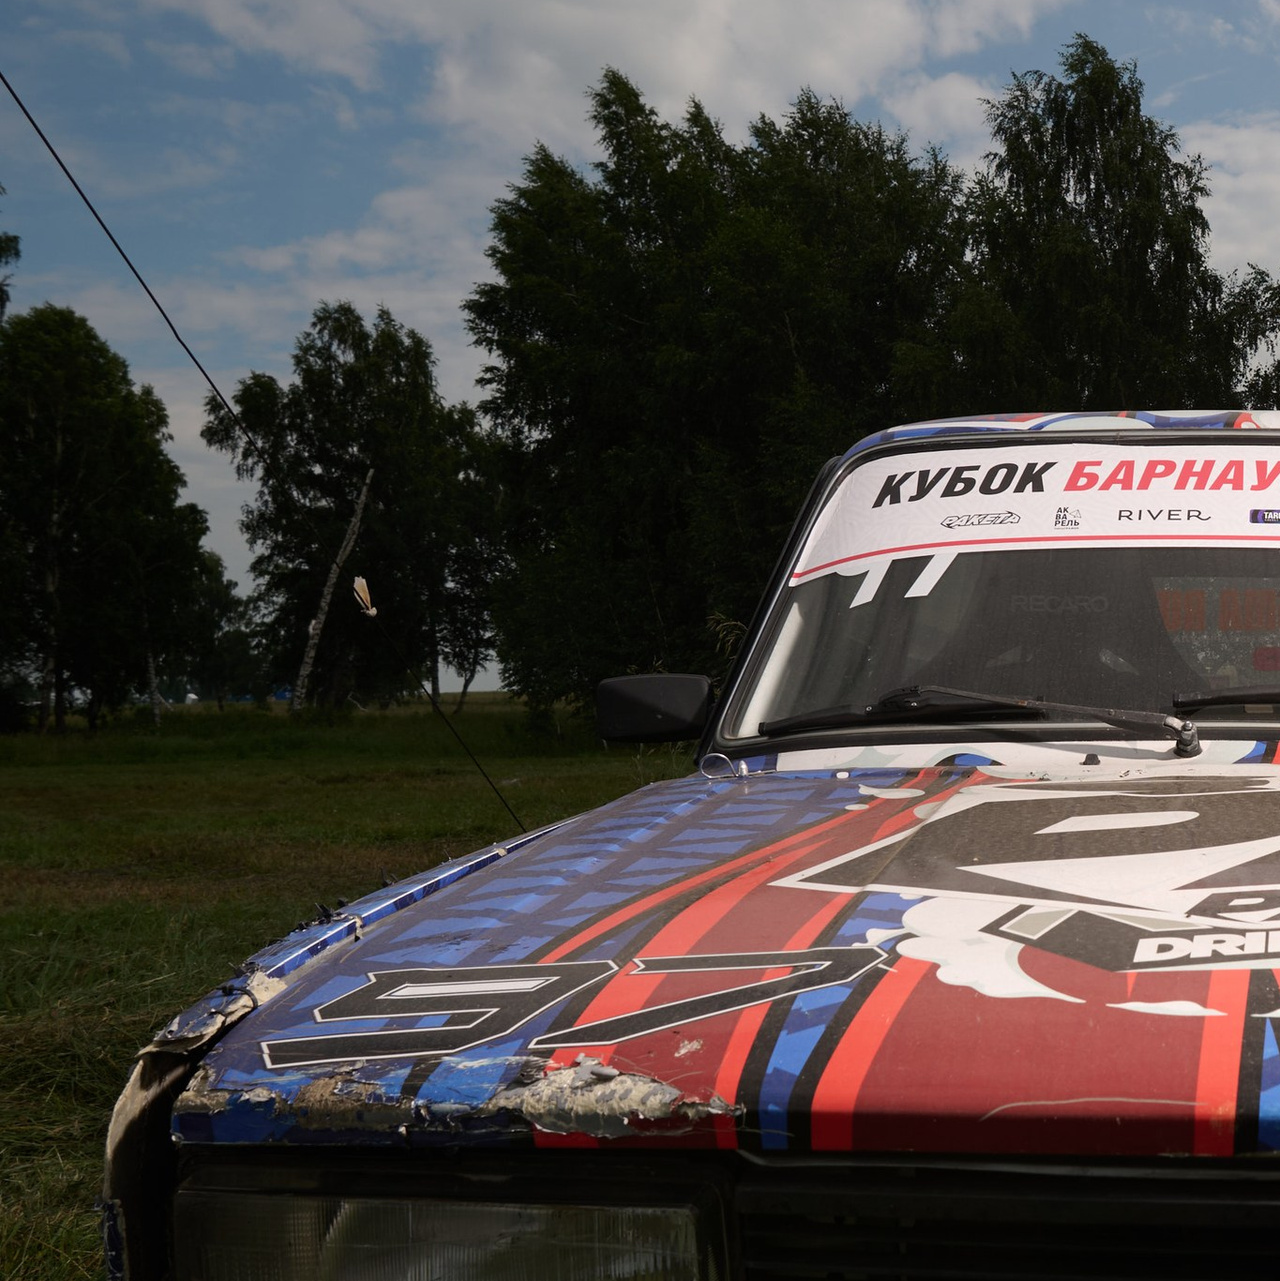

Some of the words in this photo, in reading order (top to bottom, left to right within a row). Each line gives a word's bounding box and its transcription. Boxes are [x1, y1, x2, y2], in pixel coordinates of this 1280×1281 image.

[872, 461, 1057, 509] КУБОК
[1118, 509, 1211, 521] RIVER
[1010, 594, 1109, 613] RECARO
[260, 946, 890, 1070] 97
